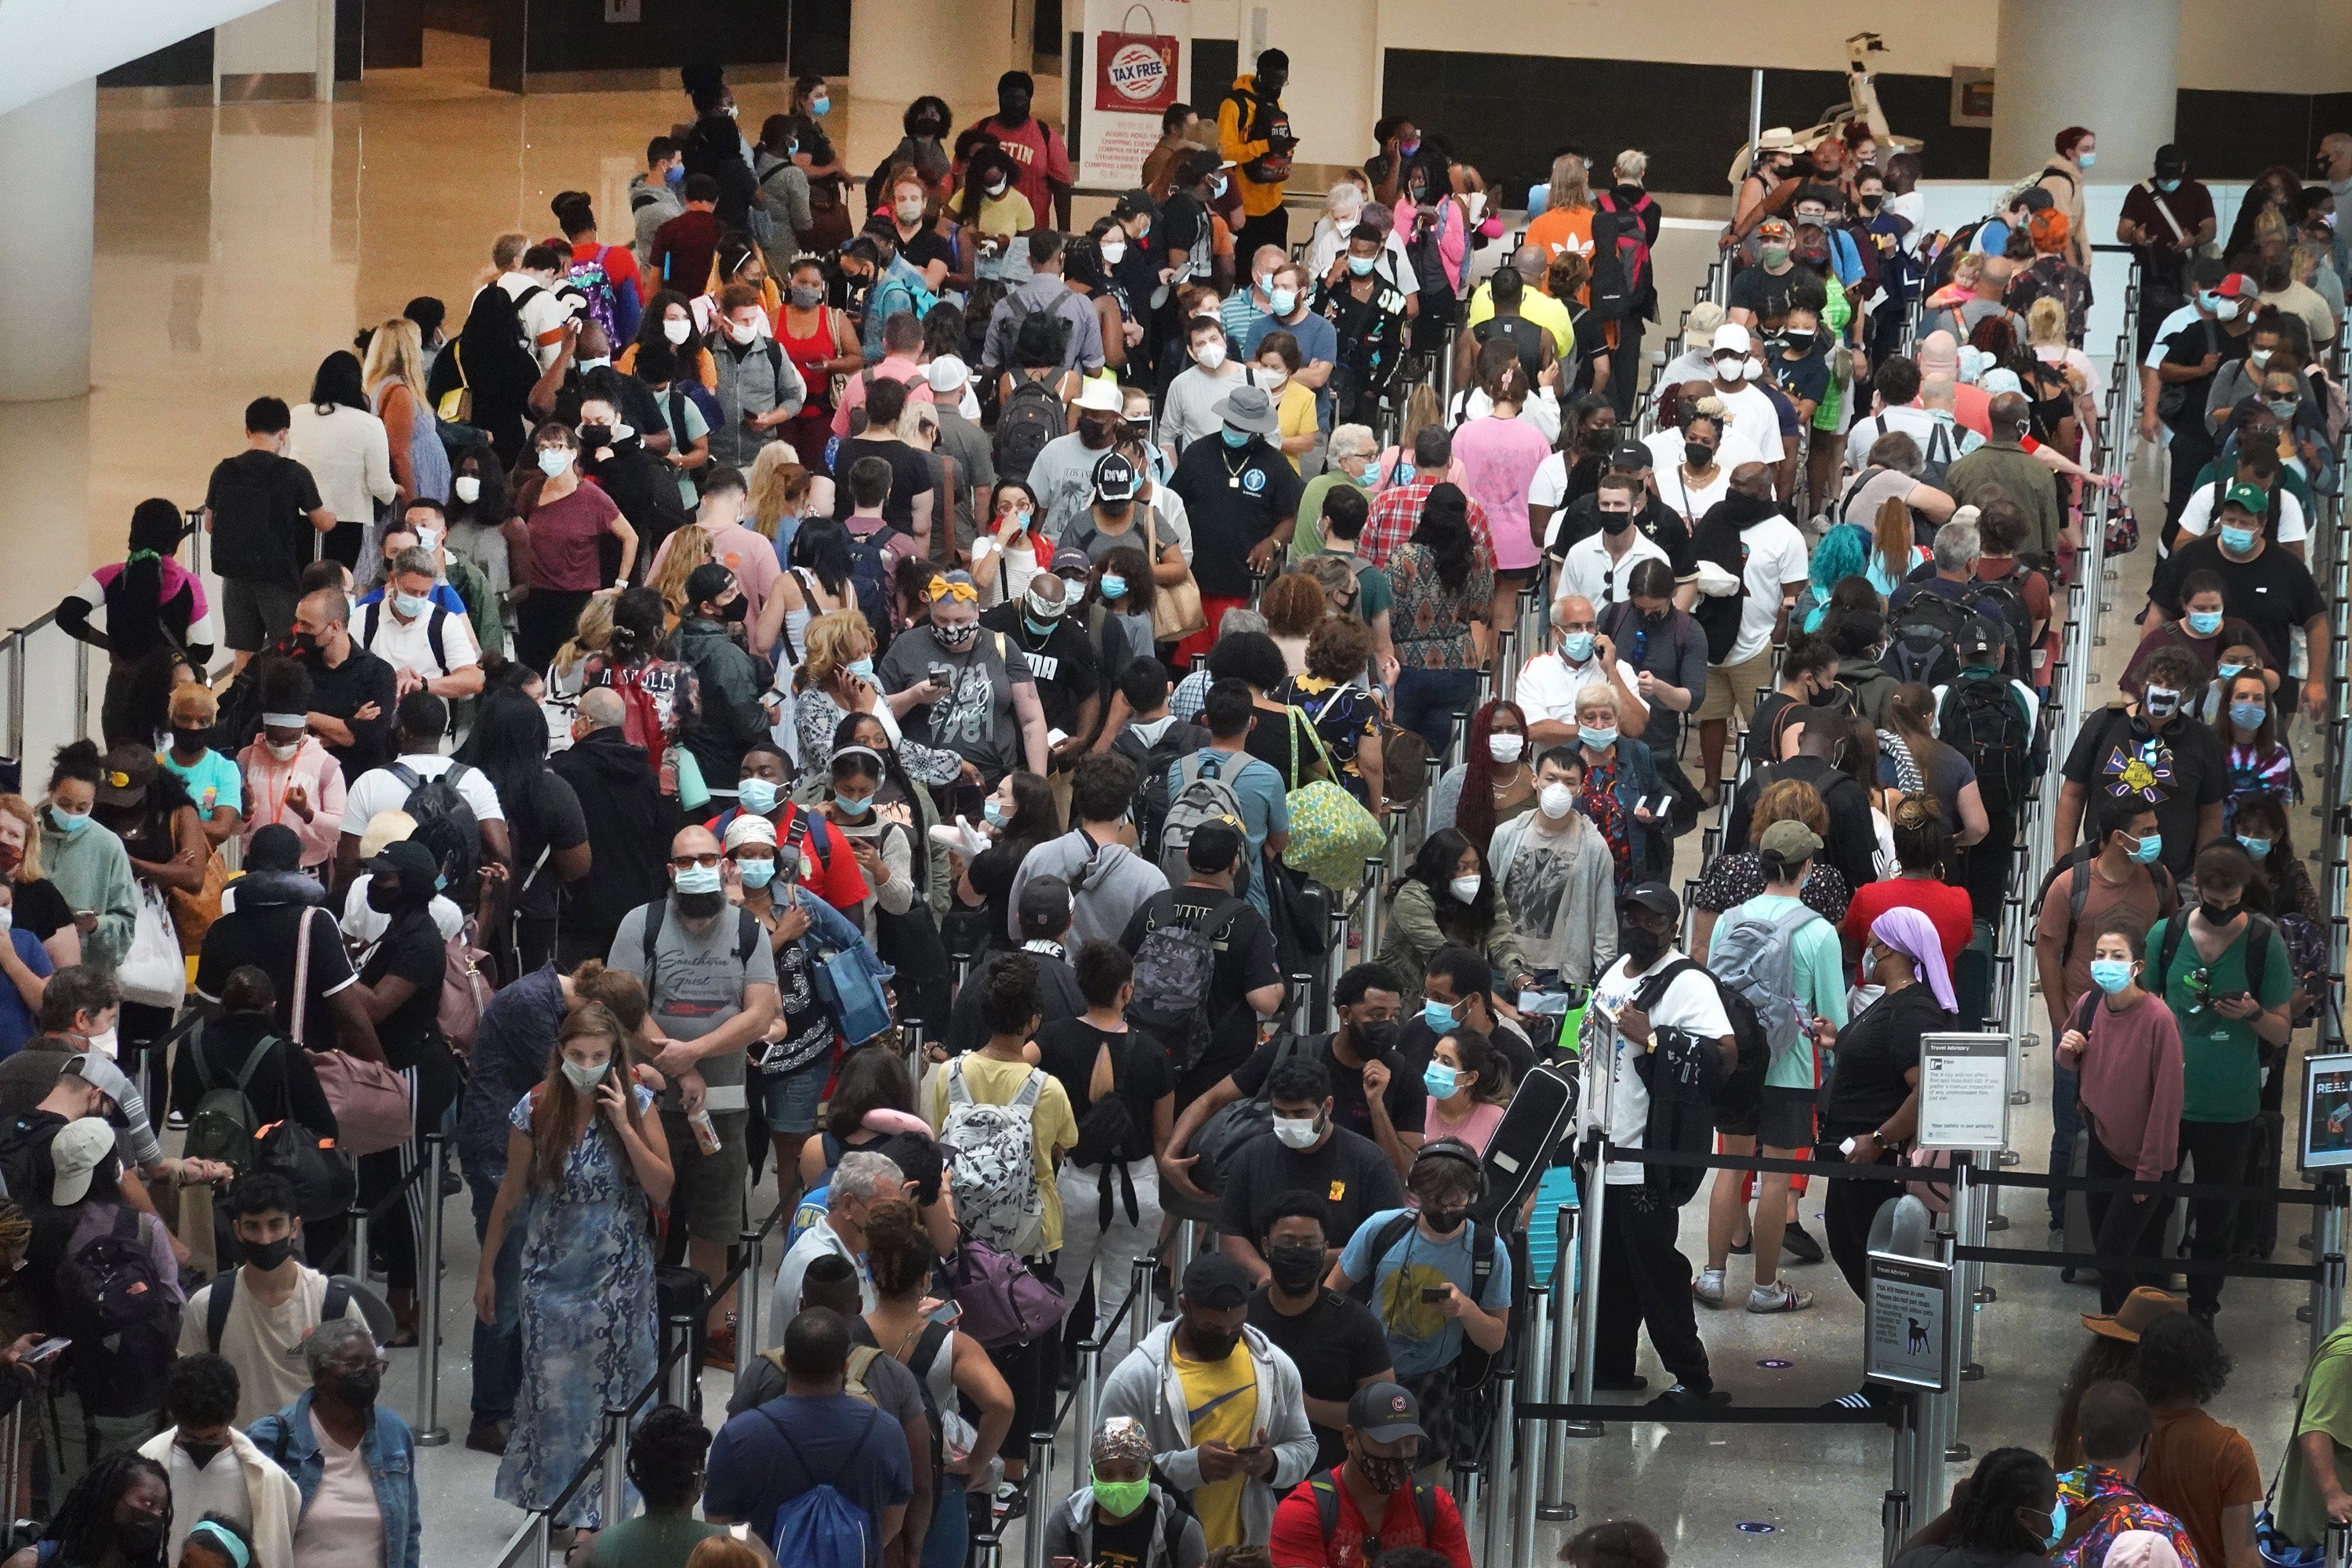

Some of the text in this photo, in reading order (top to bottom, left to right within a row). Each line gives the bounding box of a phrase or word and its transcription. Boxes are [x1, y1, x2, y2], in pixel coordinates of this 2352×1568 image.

[1112, 61, 1163, 82] TAX FREE
[1104, 469, 1128, 482] DIVA
[1023, 652, 1058, 681] MA
[1020, 938, 1063, 958] NIKE
[658, 949, 729, 970] Southern
[2316, 1082, 2348, 1094] REAL
[1877, 1266, 1910, 1277] Travel Advisory
